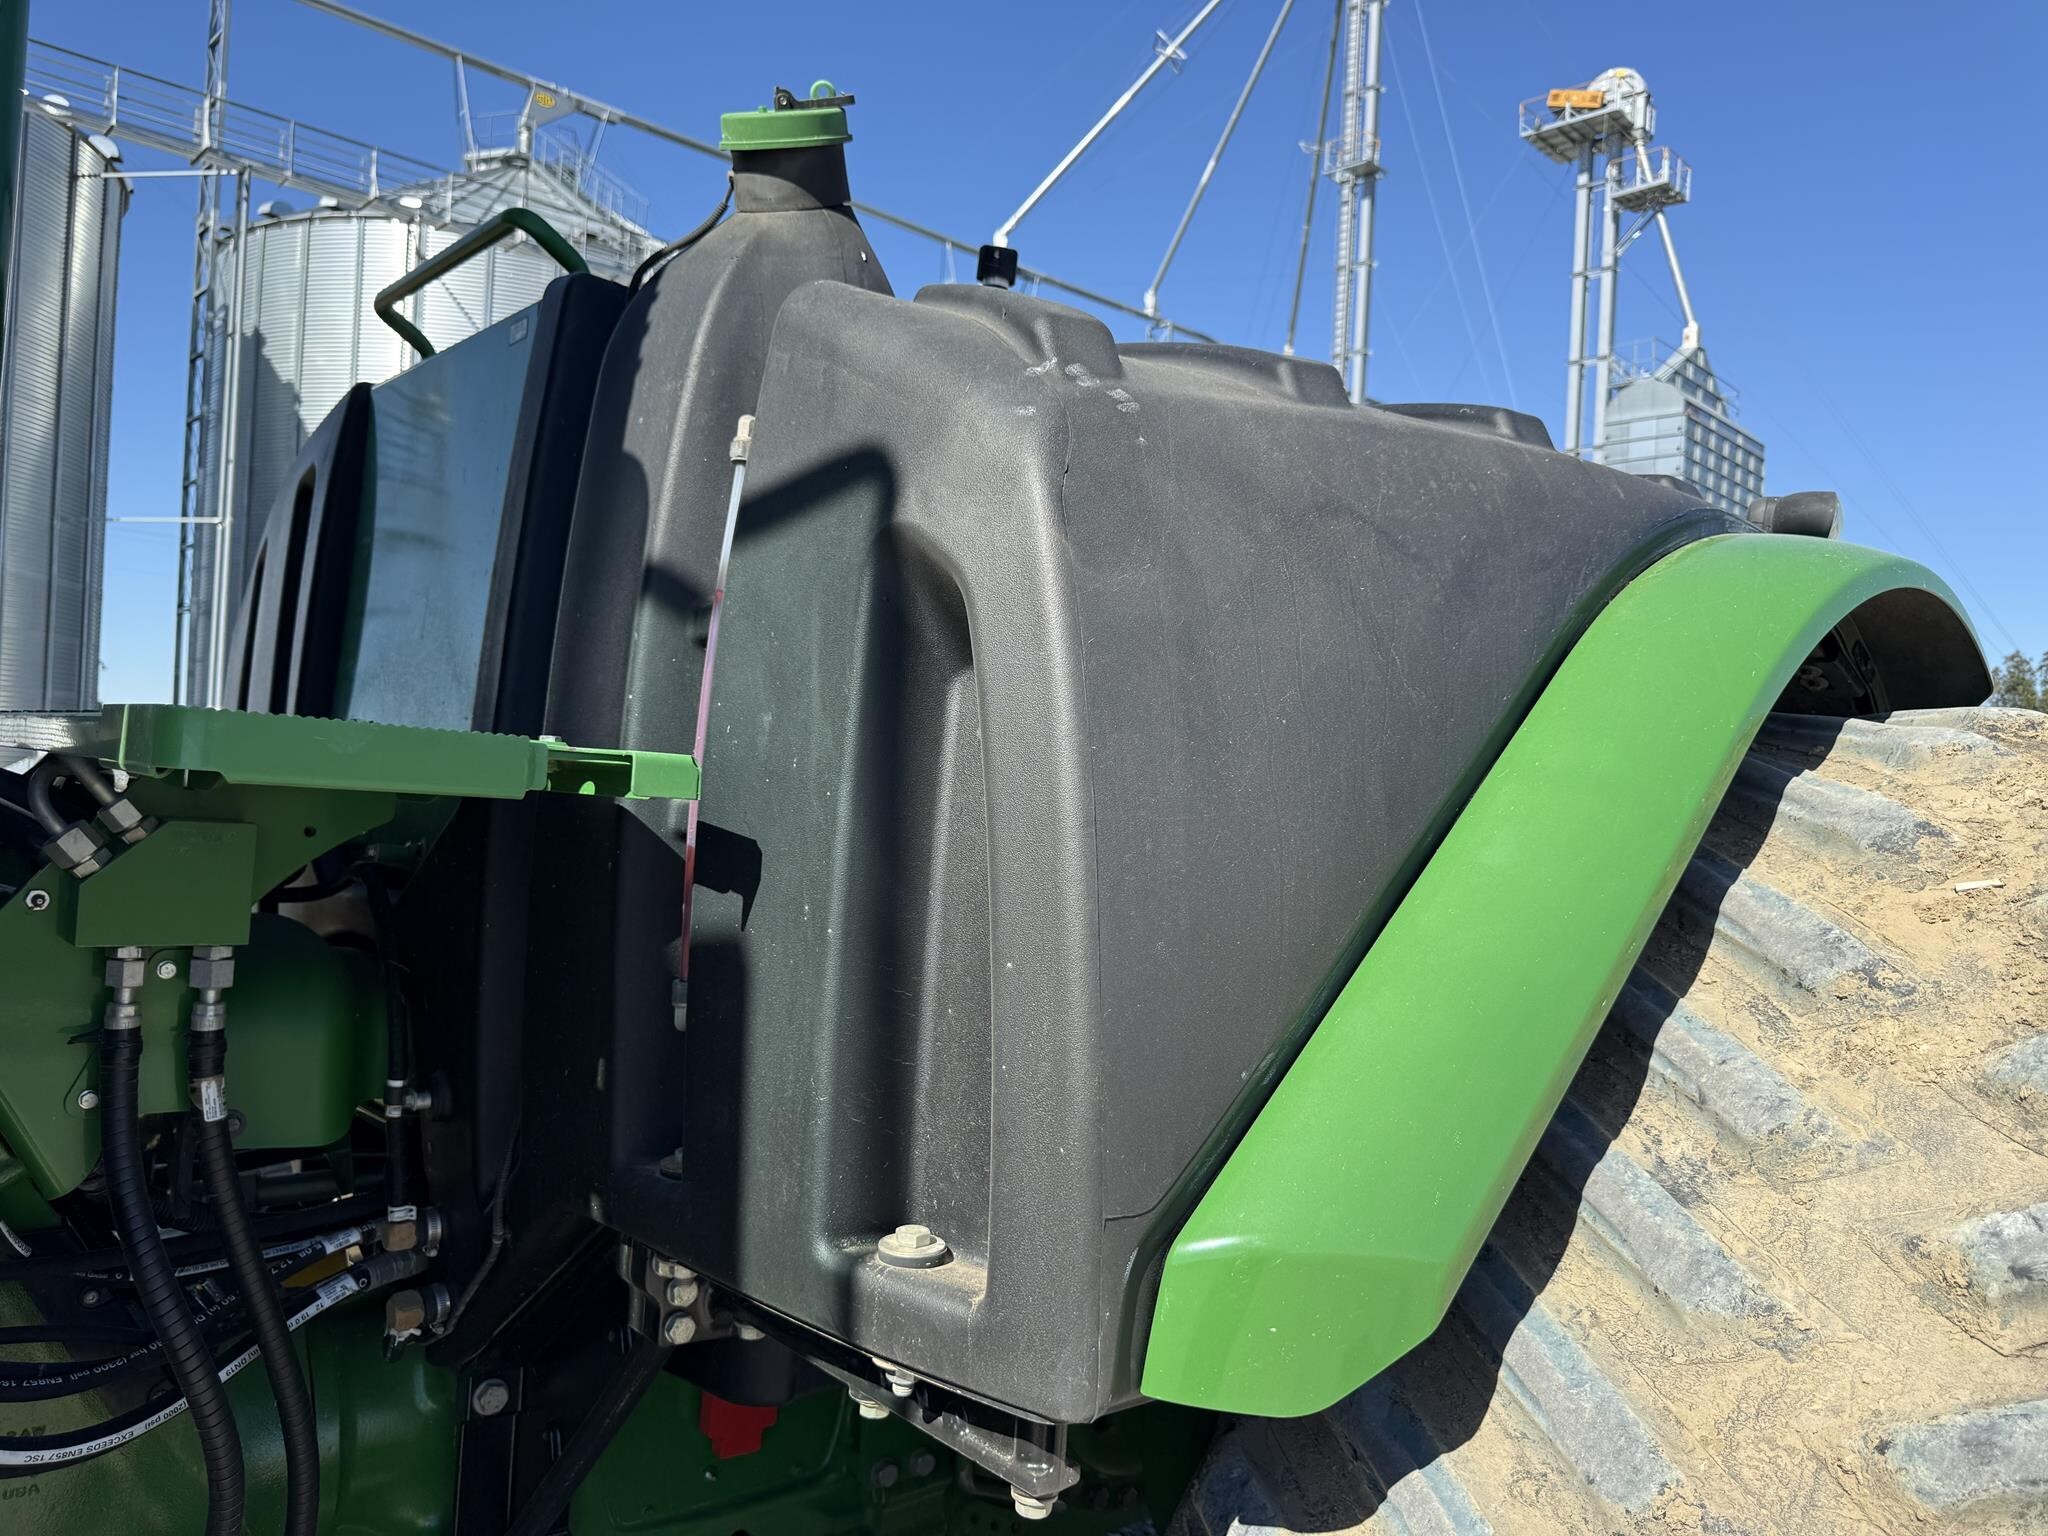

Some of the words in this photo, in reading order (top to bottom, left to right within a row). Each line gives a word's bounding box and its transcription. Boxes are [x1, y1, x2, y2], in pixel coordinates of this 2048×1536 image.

[92, 1356, 128, 1374] (2300
[225, 1357, 247, 1377] DN19
[22, 1375, 63, 1388] EN857
[163, 1400, 187, 1420] (2000
[144, 1414, 161, 1429] psi)
[86, 1431, 134, 1452] EXCEEDS
[23, 1454, 47, 1464] 1SC
[48, 1447, 83, 1461] EN857
